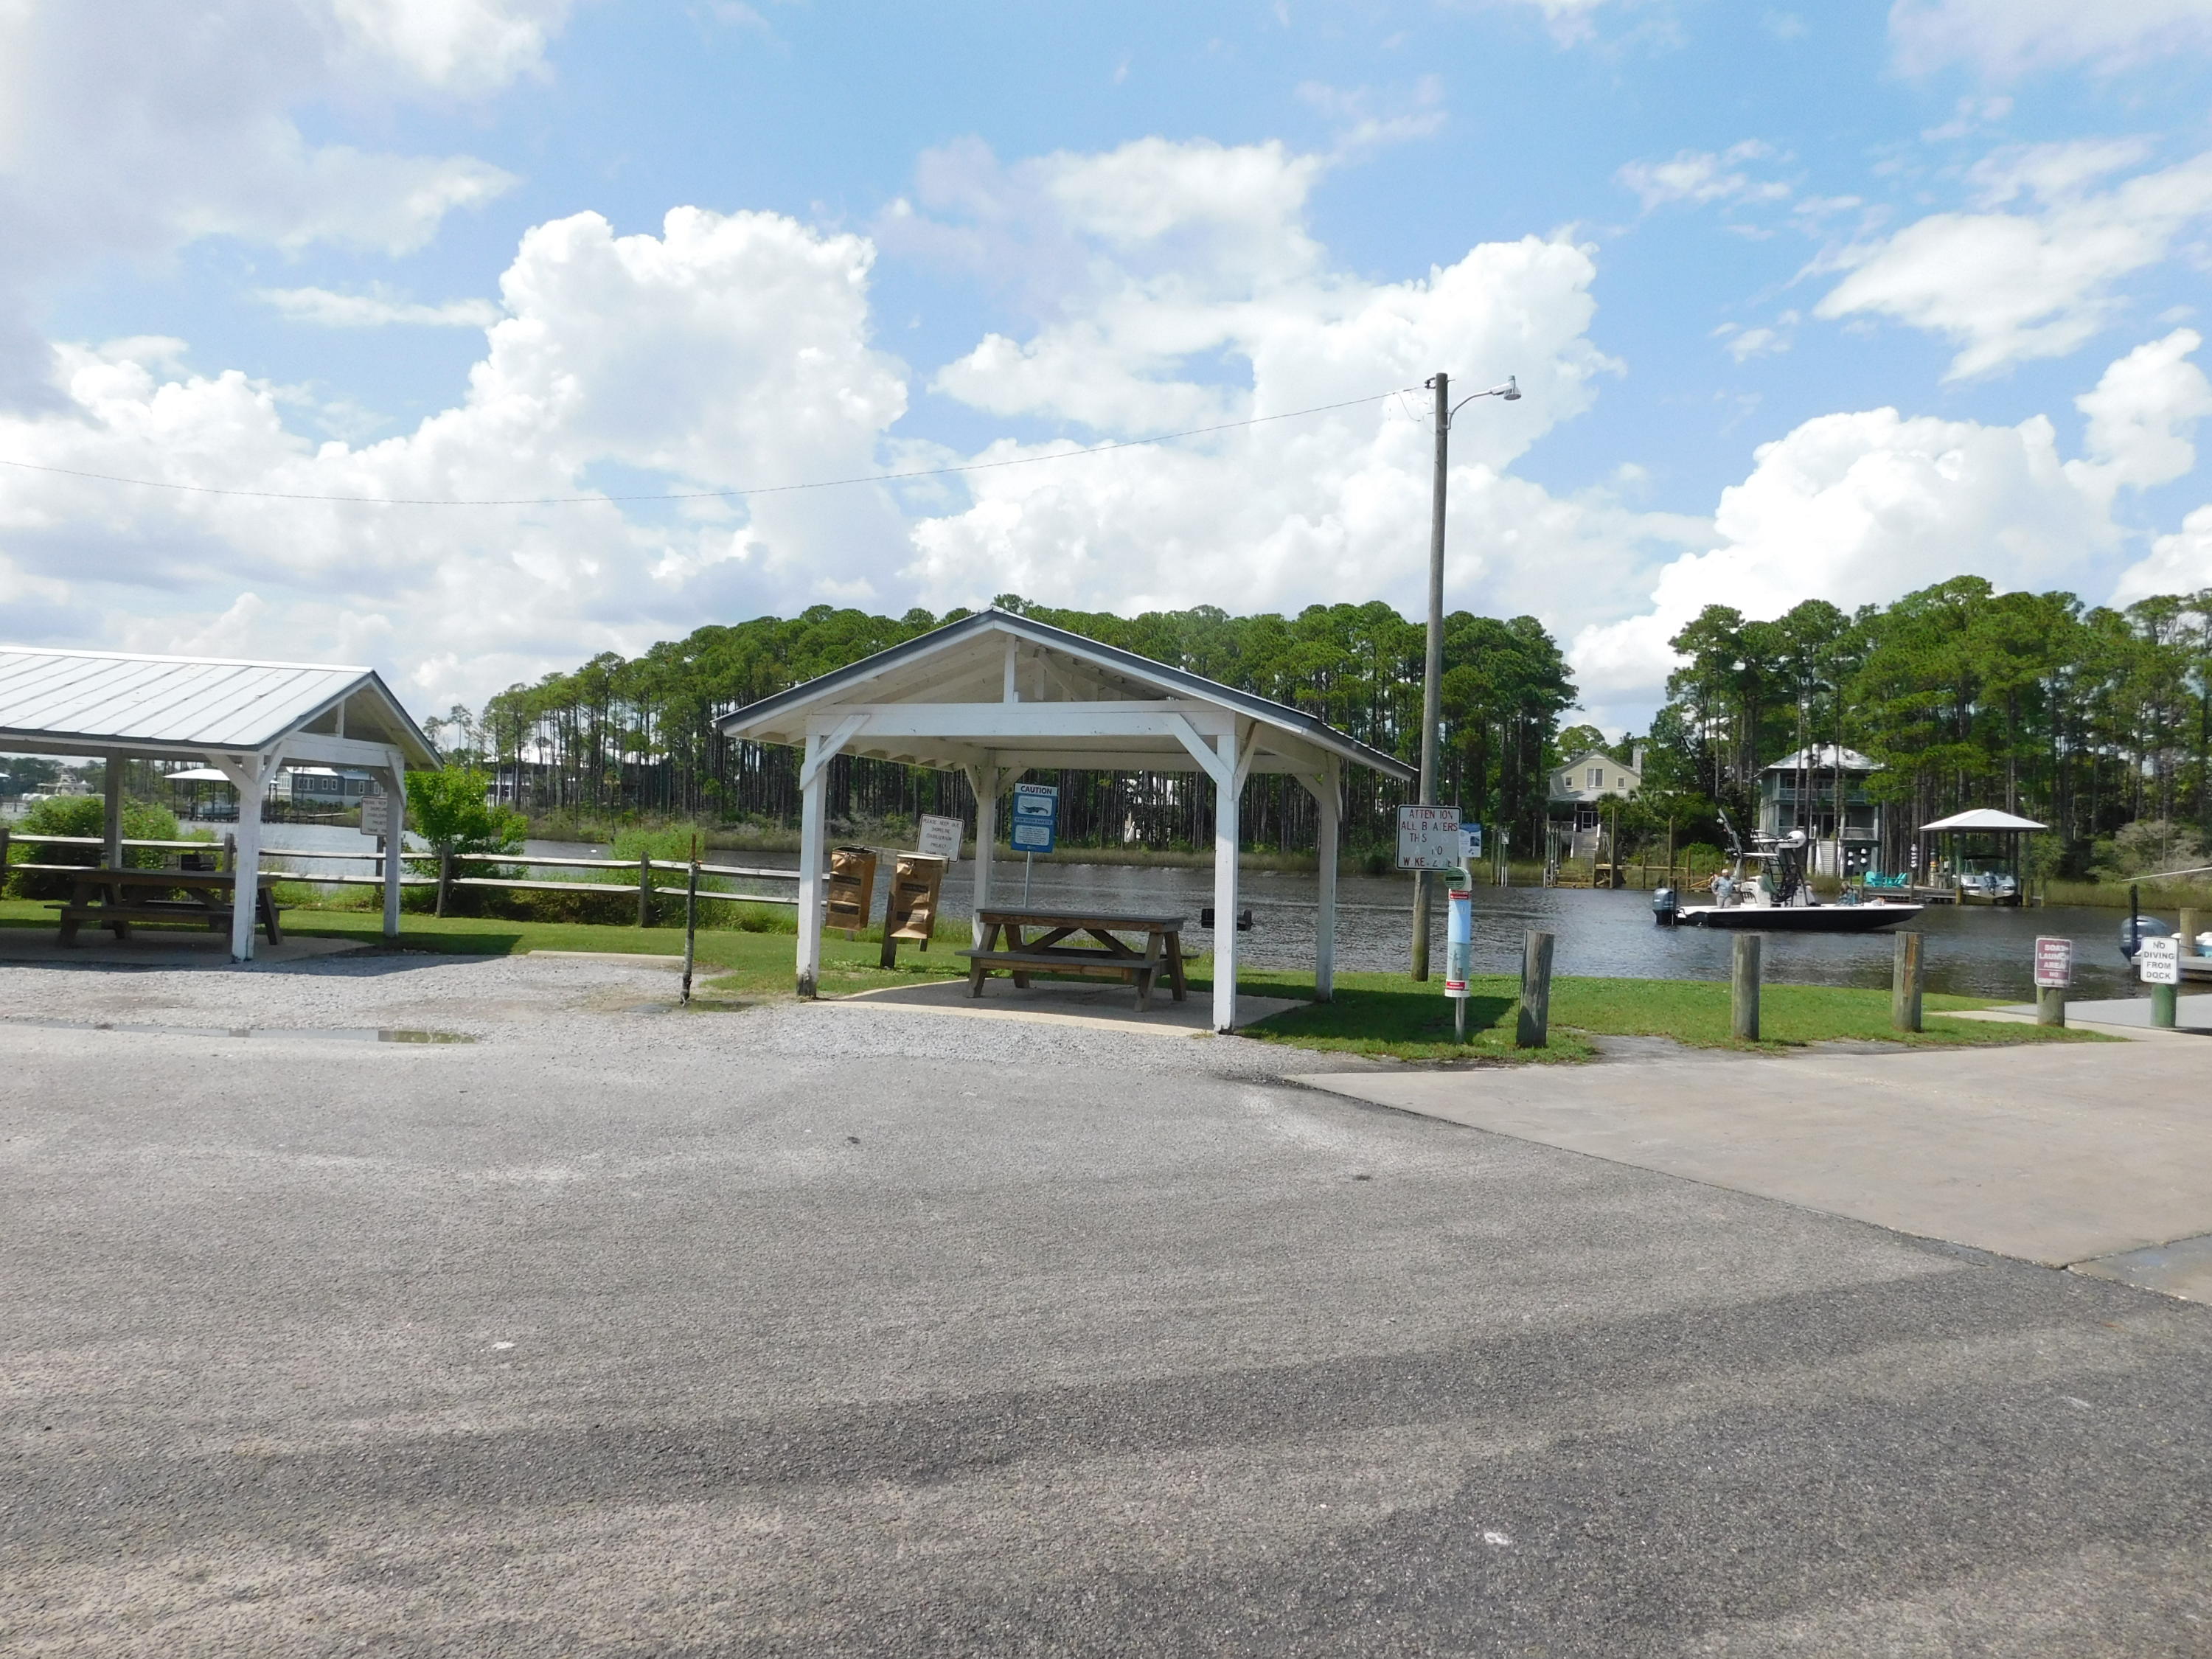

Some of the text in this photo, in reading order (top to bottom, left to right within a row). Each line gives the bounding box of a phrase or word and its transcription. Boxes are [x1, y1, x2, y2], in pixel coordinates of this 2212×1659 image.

[1020, 785, 1053, 795] CAUTION
[1409, 809, 1453, 819] ATTENION
[1401, 821, 1458, 832] ALL BAERS
[1410, 832, 1427, 842] THS
[1403, 857, 1425, 866] WKE
[2153, 941, 2166, 949] NO
[2039, 952, 2070, 960] LAUNCH
[2144, 951, 2174, 959] DIVING
[2043, 961, 2066, 970] AREA
[2146, 971, 2171, 979] DOCK
